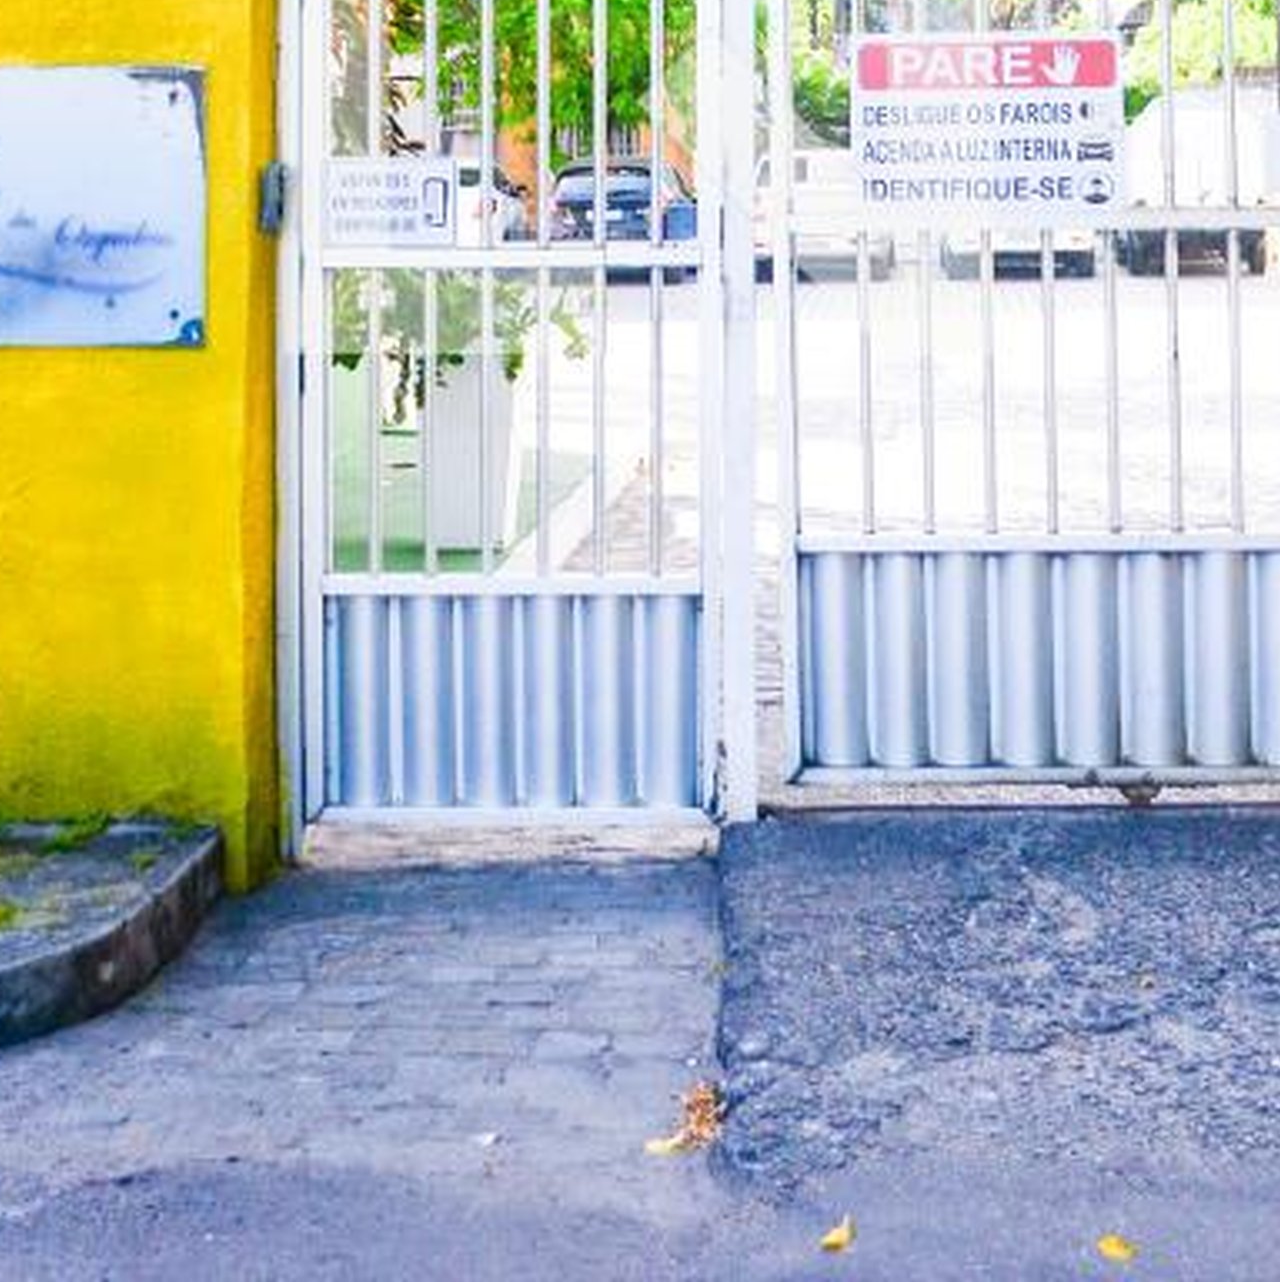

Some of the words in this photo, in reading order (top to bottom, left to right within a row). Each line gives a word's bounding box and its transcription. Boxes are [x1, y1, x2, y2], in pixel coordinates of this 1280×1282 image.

[891, 45, 1033, 85] PARE
[863, 104, 960, 126] DESLIGUE
[966, 103, 996, 125] OS
[863, 139, 937, 164] ACENDA
[939, 138, 955, 162] A
[956, 138, 990, 161] LUZ
[992, 137, 1072, 161] INTERNA
[862, 175, 1074, 202] IDENTIFIQUE-SE
